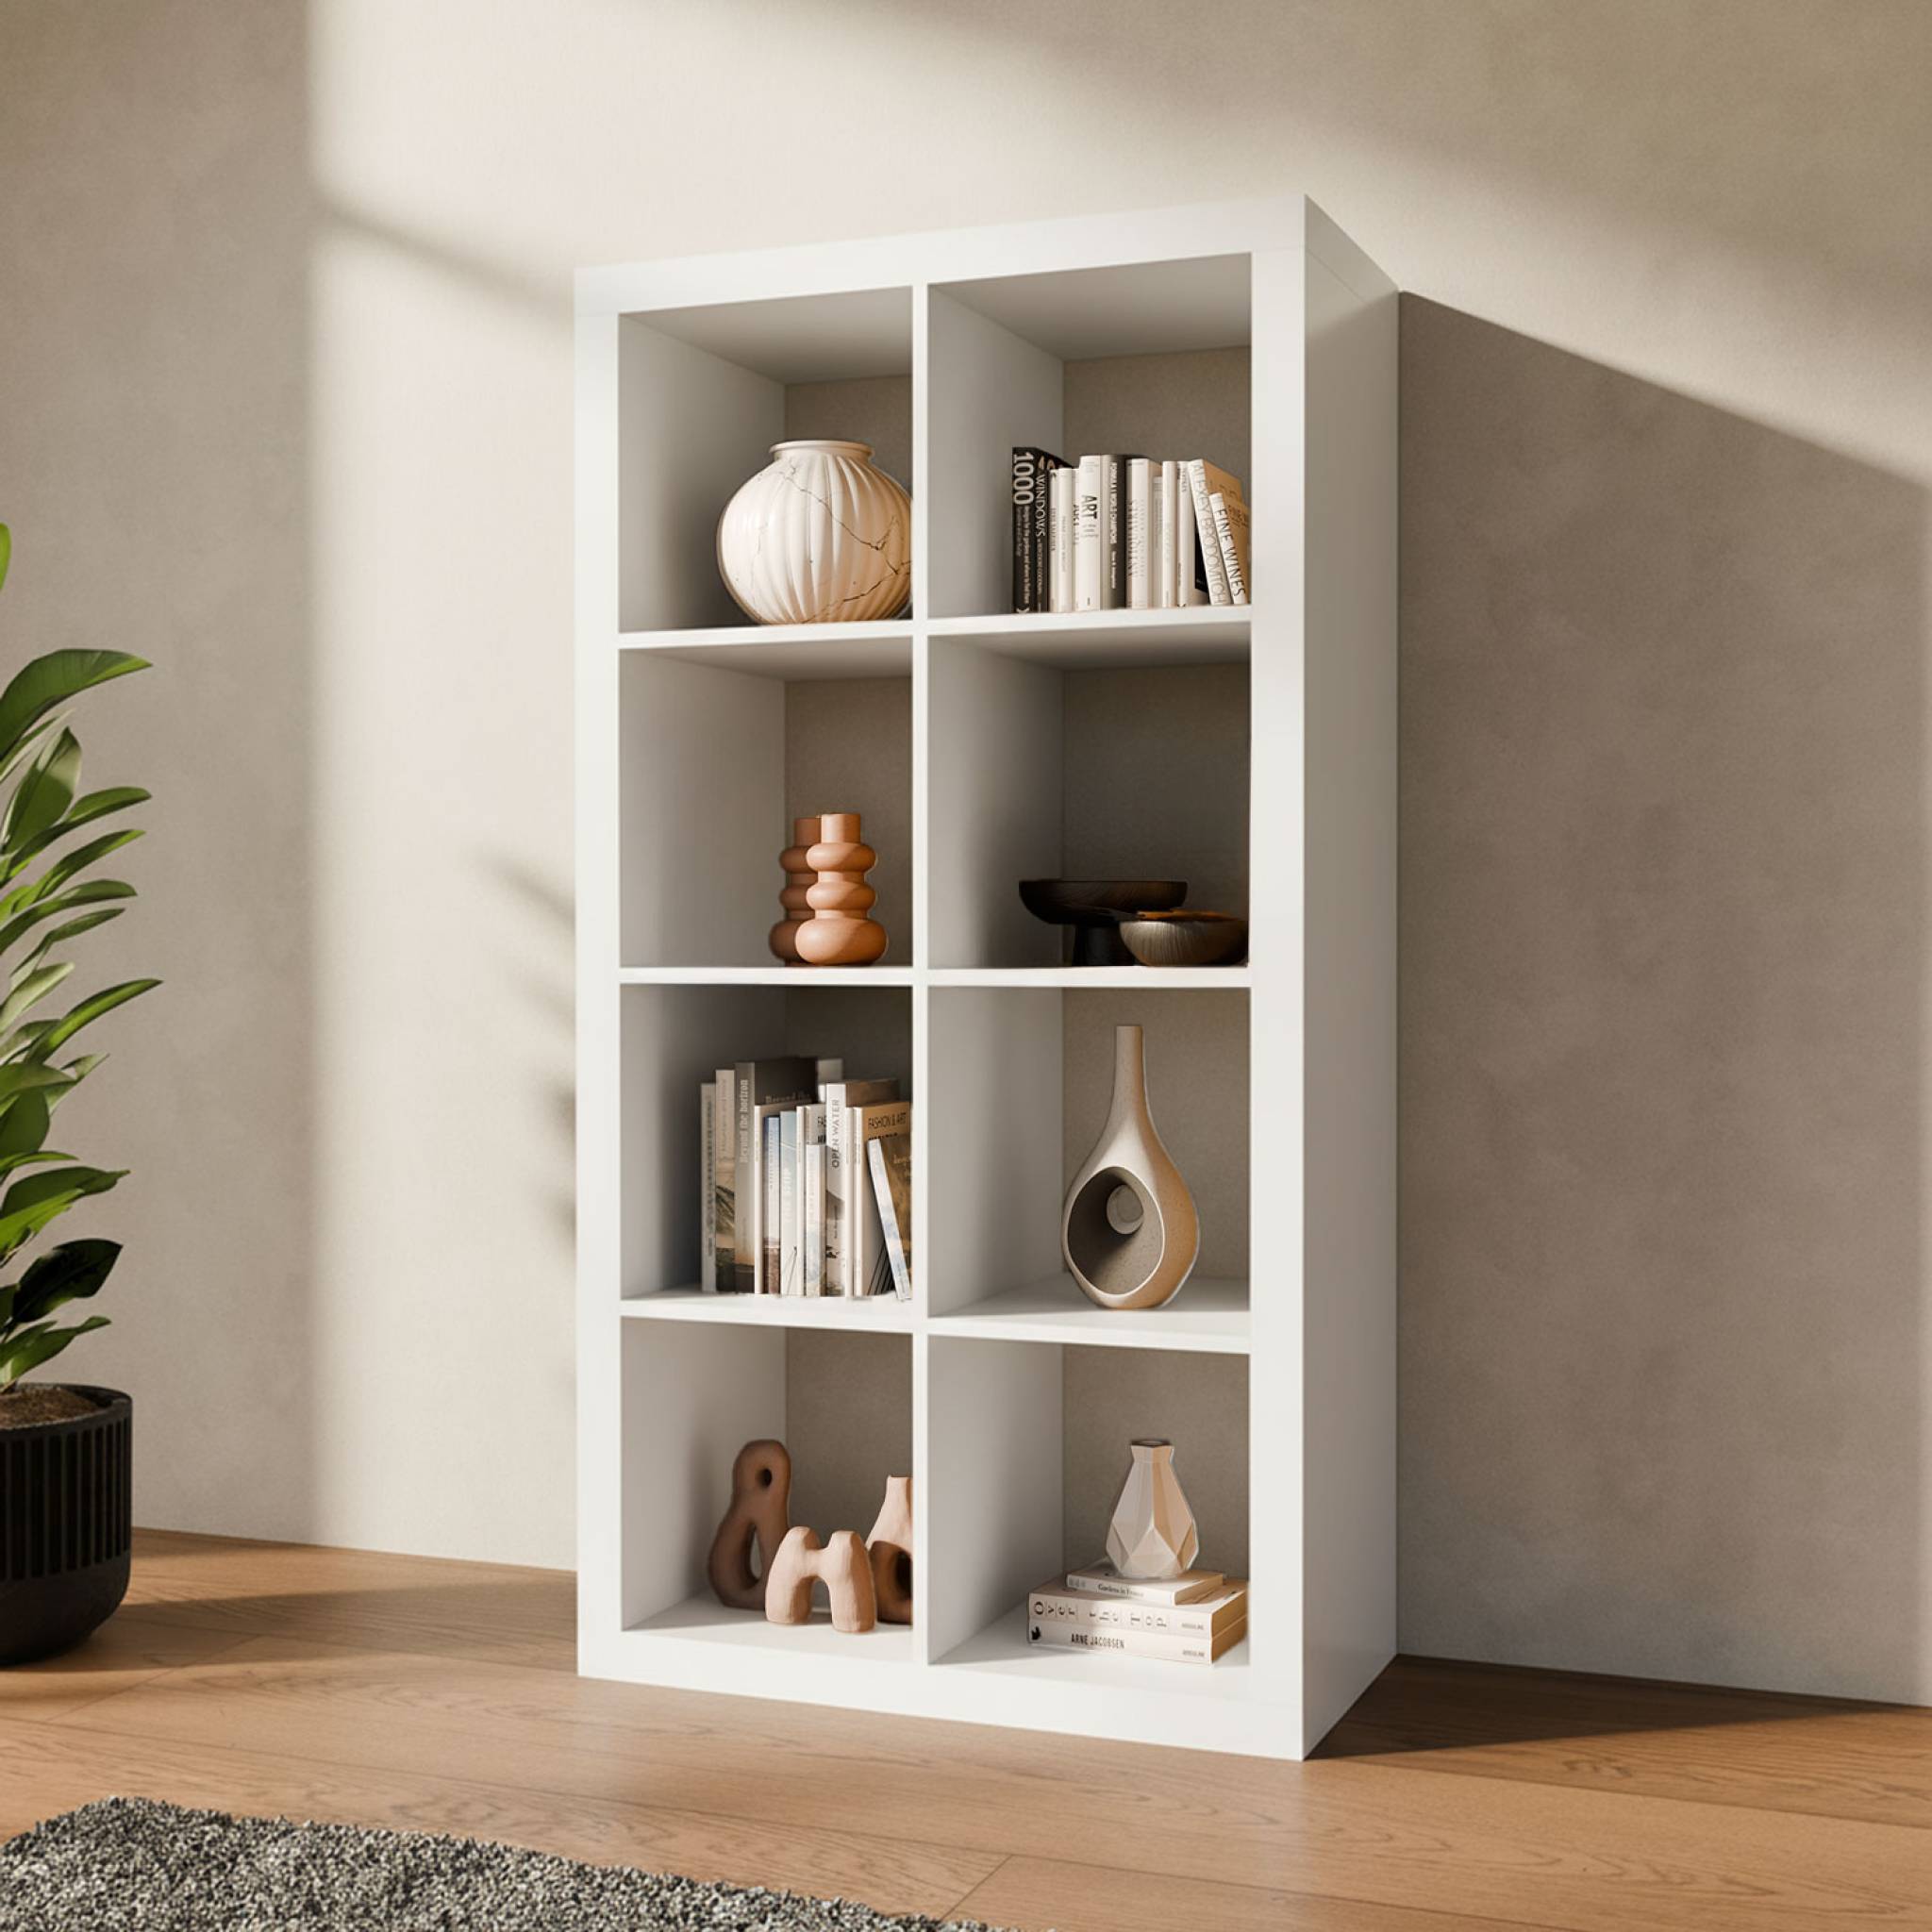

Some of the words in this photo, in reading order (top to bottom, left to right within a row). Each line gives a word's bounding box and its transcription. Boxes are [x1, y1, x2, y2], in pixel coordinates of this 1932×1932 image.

[1013, 452, 1034, 505] 1000
[1036, 474, 1045, 537] WINDOWS
[1082, 494, 1097, 519] ART
[1218, 508, 1233, 541] FINE
[1226, 546, 1245, 596] WINES
[739, 1079, 748, 1112] horizon
[739, 1114, 748, 1128] the
[831, 1099, 840, 1136] WATER
[739, 1130, 748, 1163] Beyond
[831, 1137, 840, 1168] OPEN
[1034, 1602, 1075, 1616] Over
[1089, 1611, 1118, 1622] the
[1130, 1613, 1167, 1628] Top
[1071, 1633, 1088, 1646] ARNE
[1090, 1636, 1125, 1649] JACOBSEN
